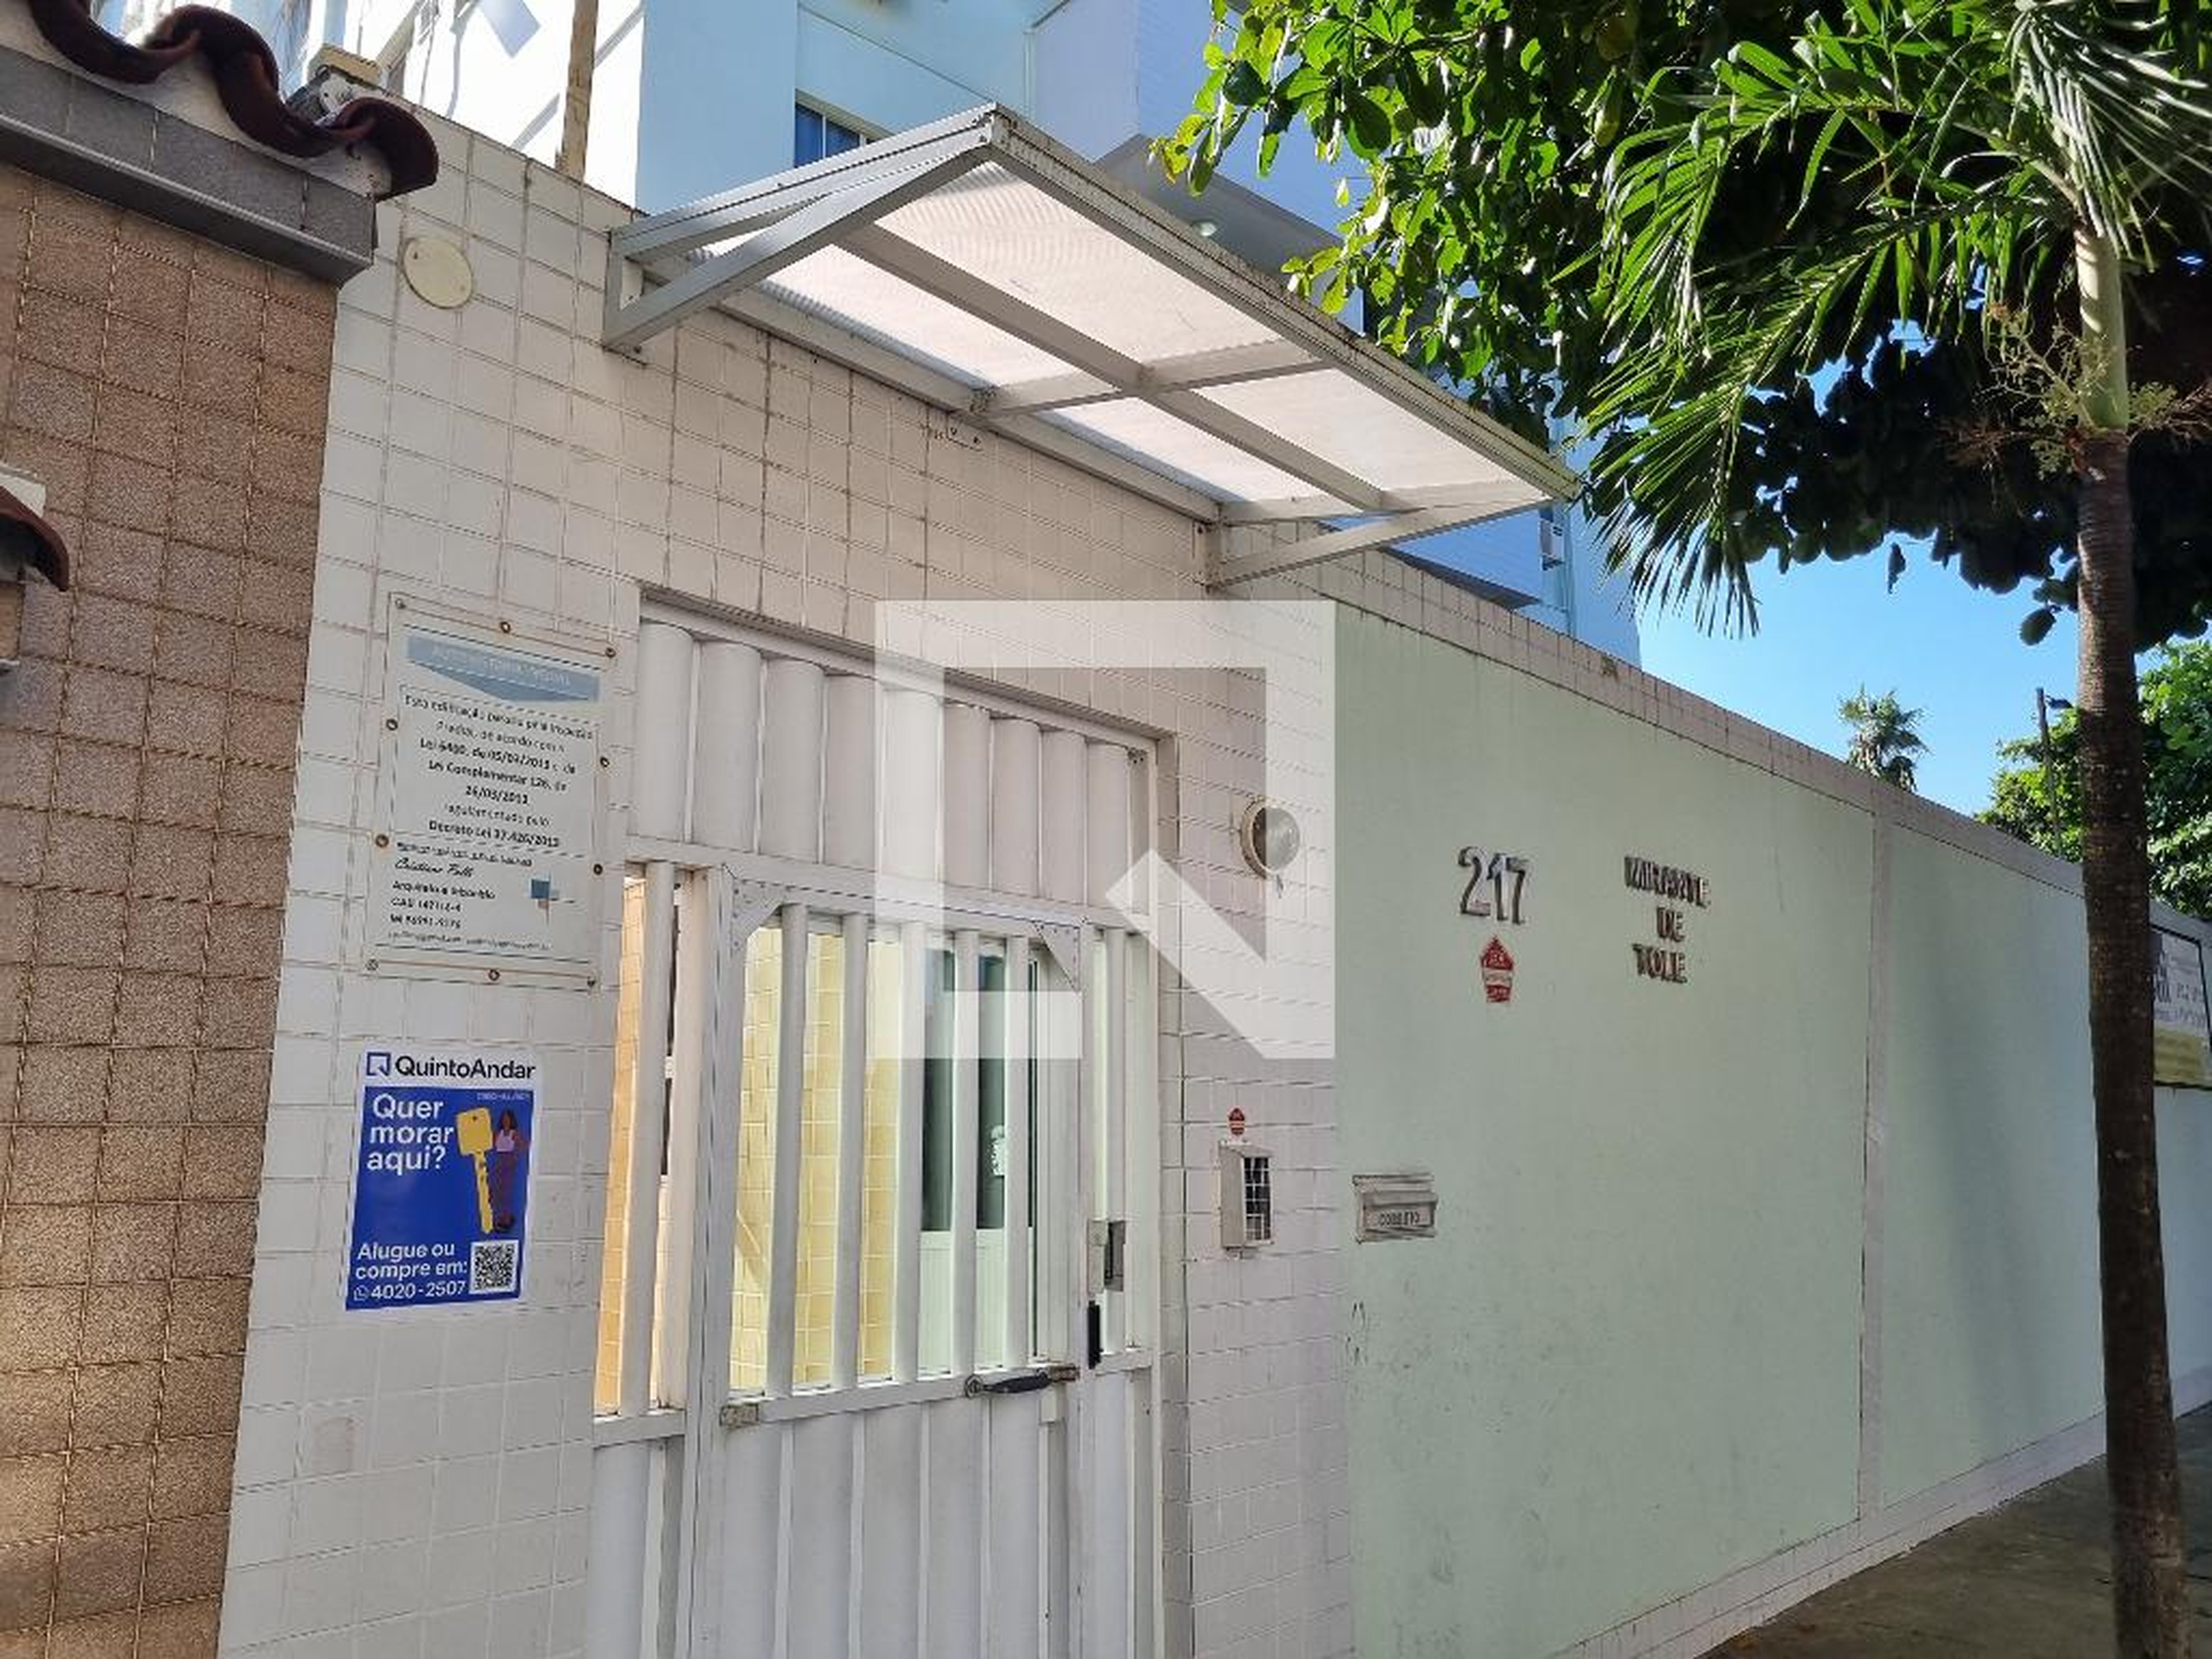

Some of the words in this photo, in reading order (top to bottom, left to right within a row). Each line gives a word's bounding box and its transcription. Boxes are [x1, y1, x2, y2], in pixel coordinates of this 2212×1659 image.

[1458, 846, 1528, 925] 217
[395, 1055, 535, 1080] QuintoAndar
[373, 1093, 444, 1119] Quer
[370, 1124, 454, 1144] morar
[367, 1146, 446, 1175] aqui?
[357, 1243, 427, 1261] Alugue
[431, 1243, 455, 1256] ou
[355, 1263, 431, 1281] compre
[435, 1260, 468, 1275] em:
